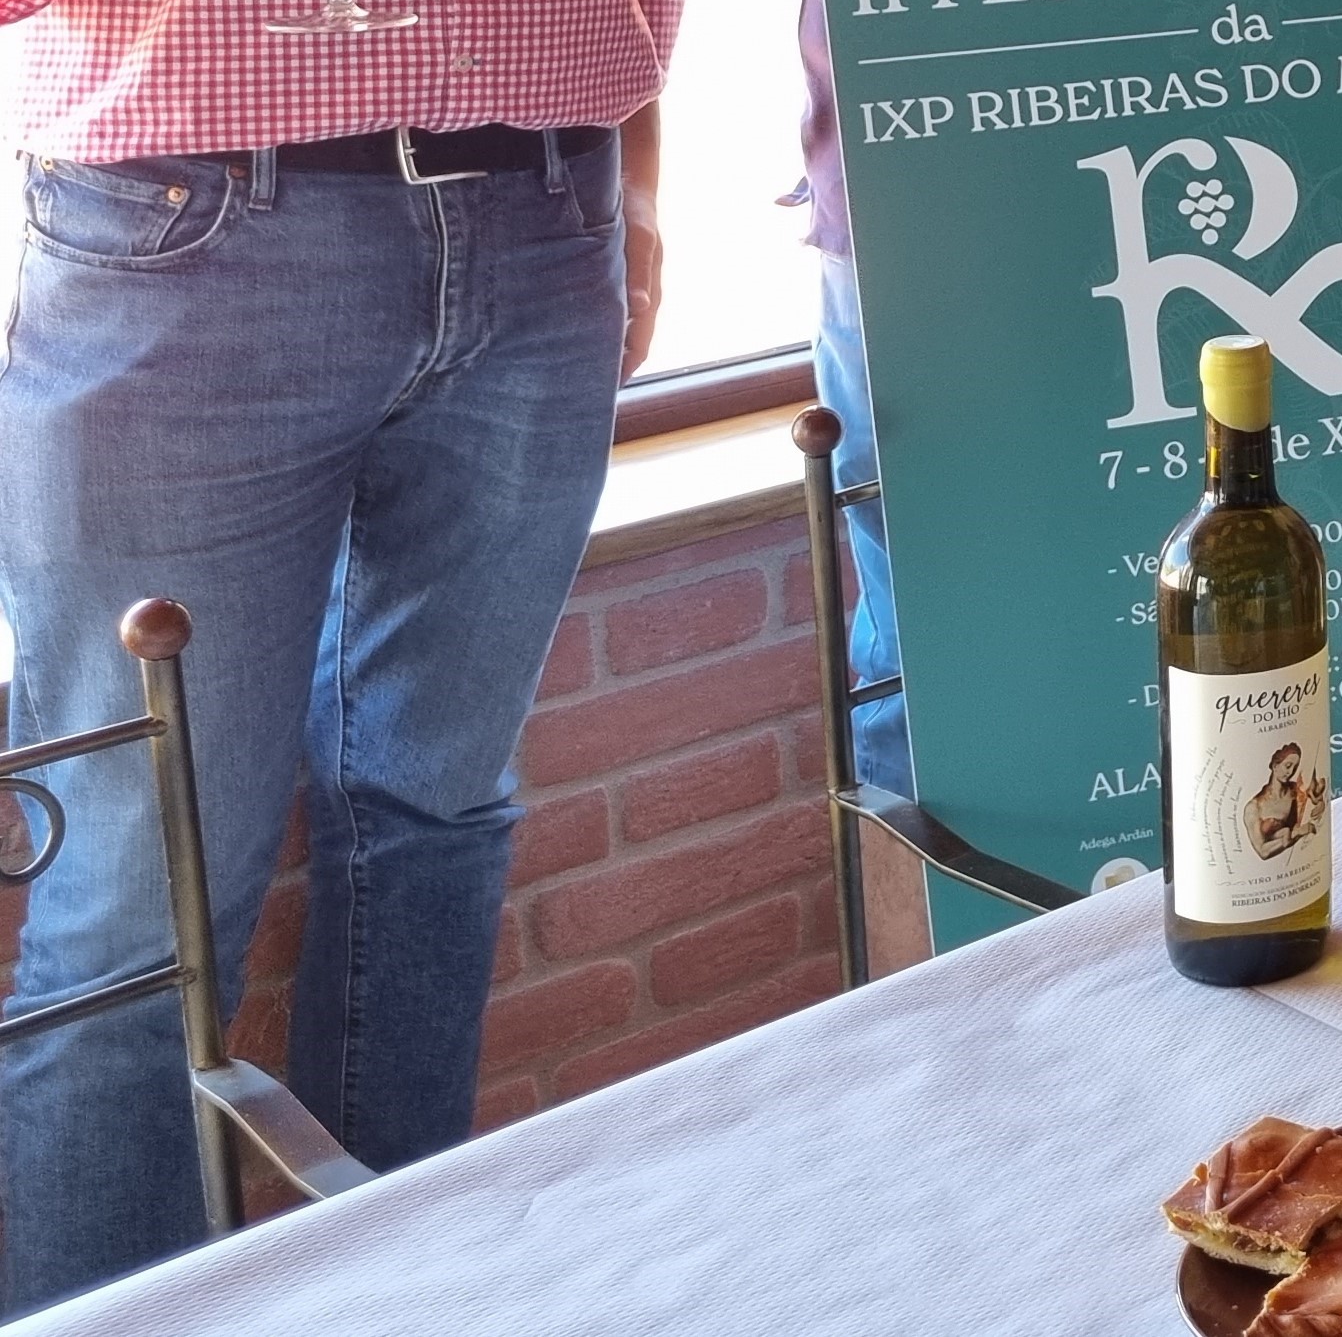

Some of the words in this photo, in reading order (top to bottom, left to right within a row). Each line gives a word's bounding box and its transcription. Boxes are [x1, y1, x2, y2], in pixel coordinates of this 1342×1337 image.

[1211, 3, 1273, 46] da
[859, 97, 954, 144] IXP
[970, 69, 1228, 133] RIBEIRAS
[1244, 59, 1321, 102] DO
[1099, 450, 1123, 490] 7
[1163, 441, 1188, 479] 8
[1122, 552, 1159, 577] Ve
[1131, 599, 1158, 625] Sá
[1216, 673, 1321, 733] quereres
[1253, 711, 1274, 724] DO
[1277, 704, 1300, 719] HÍO
[1257, 718, 1298, 733] ALBARIÑO
[1089, 762, 1162, 802] ALA
[1080, 836, 1117, 852] Adega
[1118, 828, 1154, 843] Ardán
[1248, 875, 1272, 887] VIÑO
[1276, 863, 1311, 881] MAREIRO
[1231, 895, 1272, 908] RIBEIRAS
[1273, 892, 1287, 902] DO
[1287, 876, 1322, 898] MORRAZO
